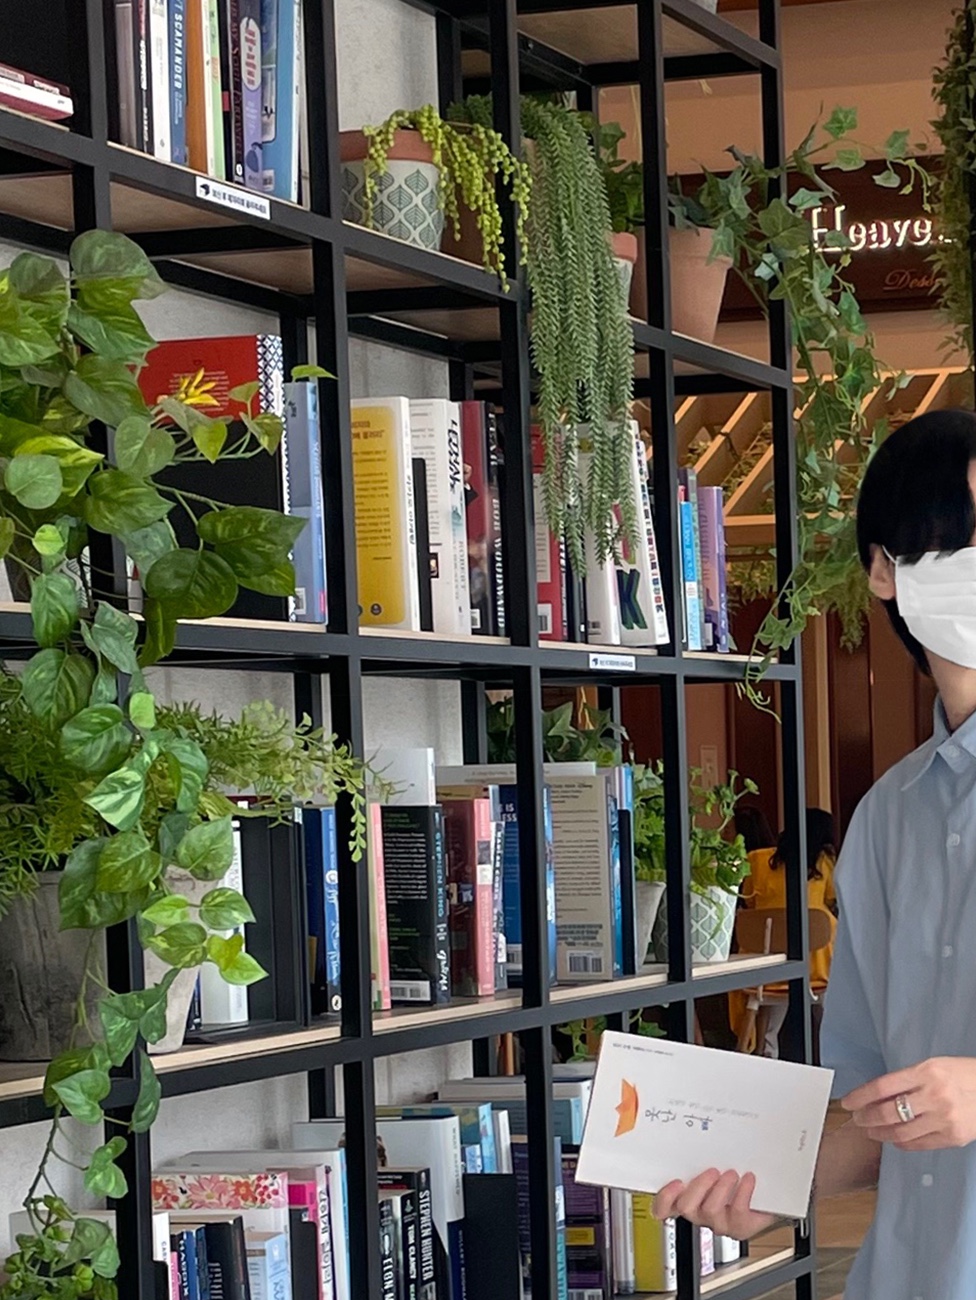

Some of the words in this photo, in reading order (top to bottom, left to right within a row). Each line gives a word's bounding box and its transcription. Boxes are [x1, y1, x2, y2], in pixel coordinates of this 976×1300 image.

[174, 14, 183, 90] SCAMANDER
[811, 204, 958, 253] Heave
[492, 499, 501, 531] BOB
[495, 539, 505, 629] WOODWARD
[434, 832, 443, 883] STEPHEN
[437, 887, 445, 919] KING
[418, 1189, 431, 1237] STEPHEN
[408, 1224, 416, 1245] TOM
[382, 1257, 393, 1289] ELON
[409, 1248, 417, 1280] CLANCY
[421, 1240, 434, 1281] HUNTER
